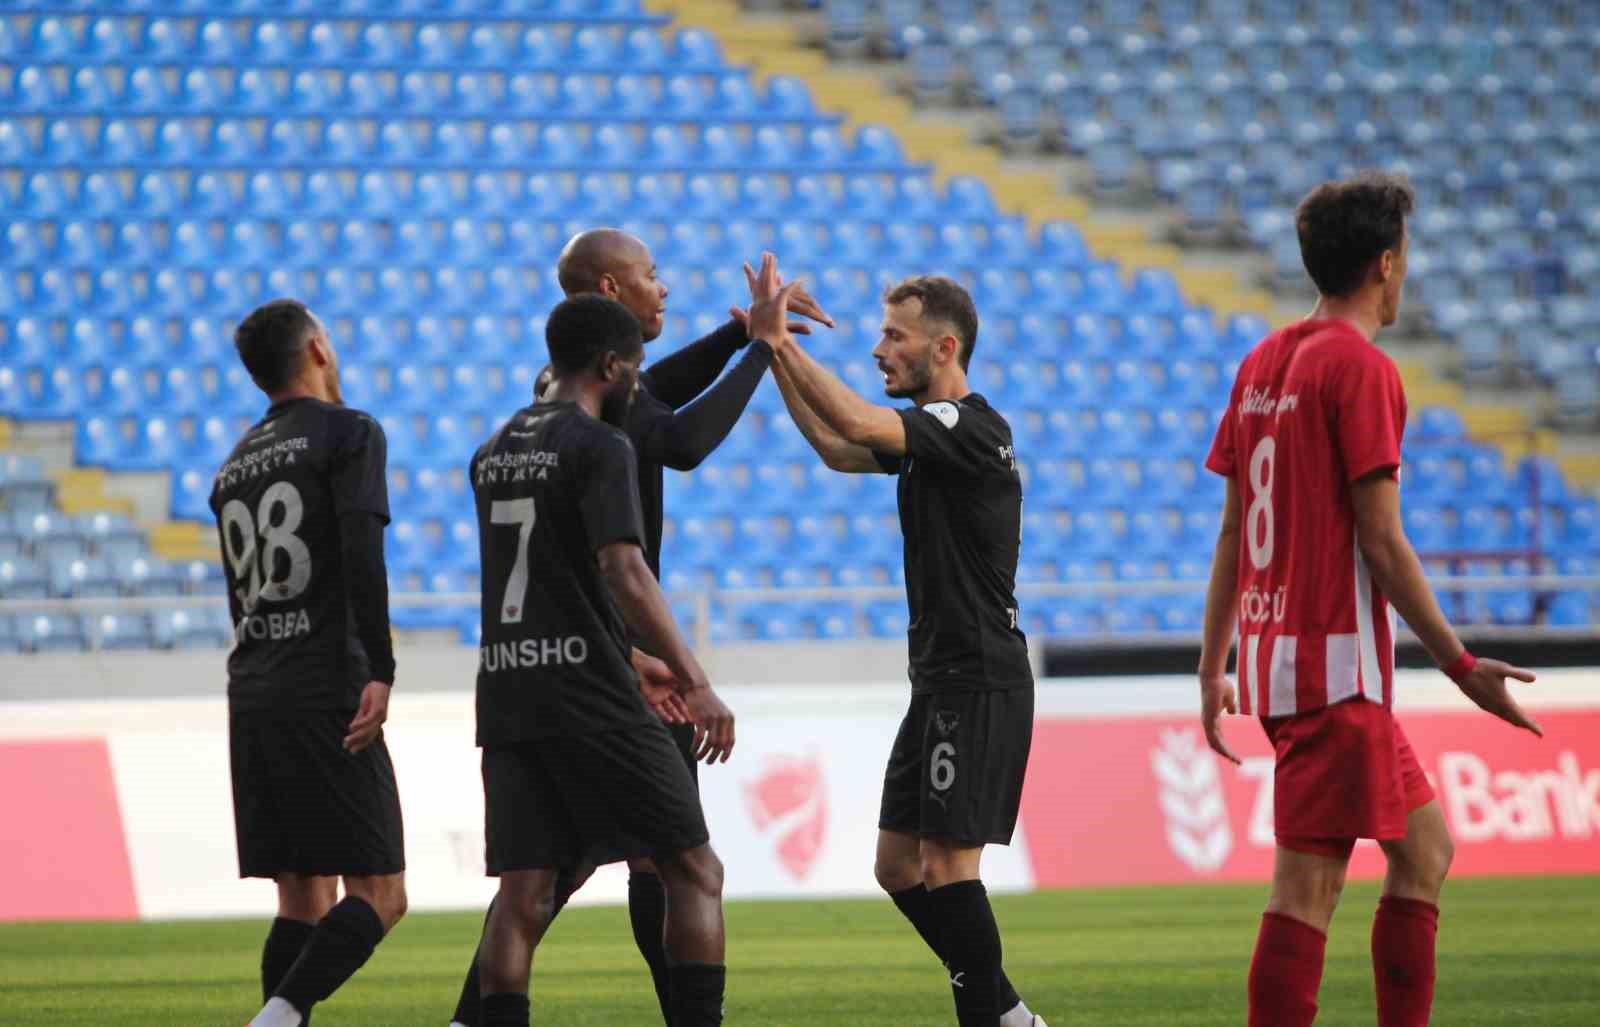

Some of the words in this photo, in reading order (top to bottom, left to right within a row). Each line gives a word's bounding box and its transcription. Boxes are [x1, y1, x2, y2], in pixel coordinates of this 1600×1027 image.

[221, 481, 312, 615] 98
[490, 497, 536, 623] 7
[1247, 435, 1276, 570] 8
[930, 742, 956, 791] 6
